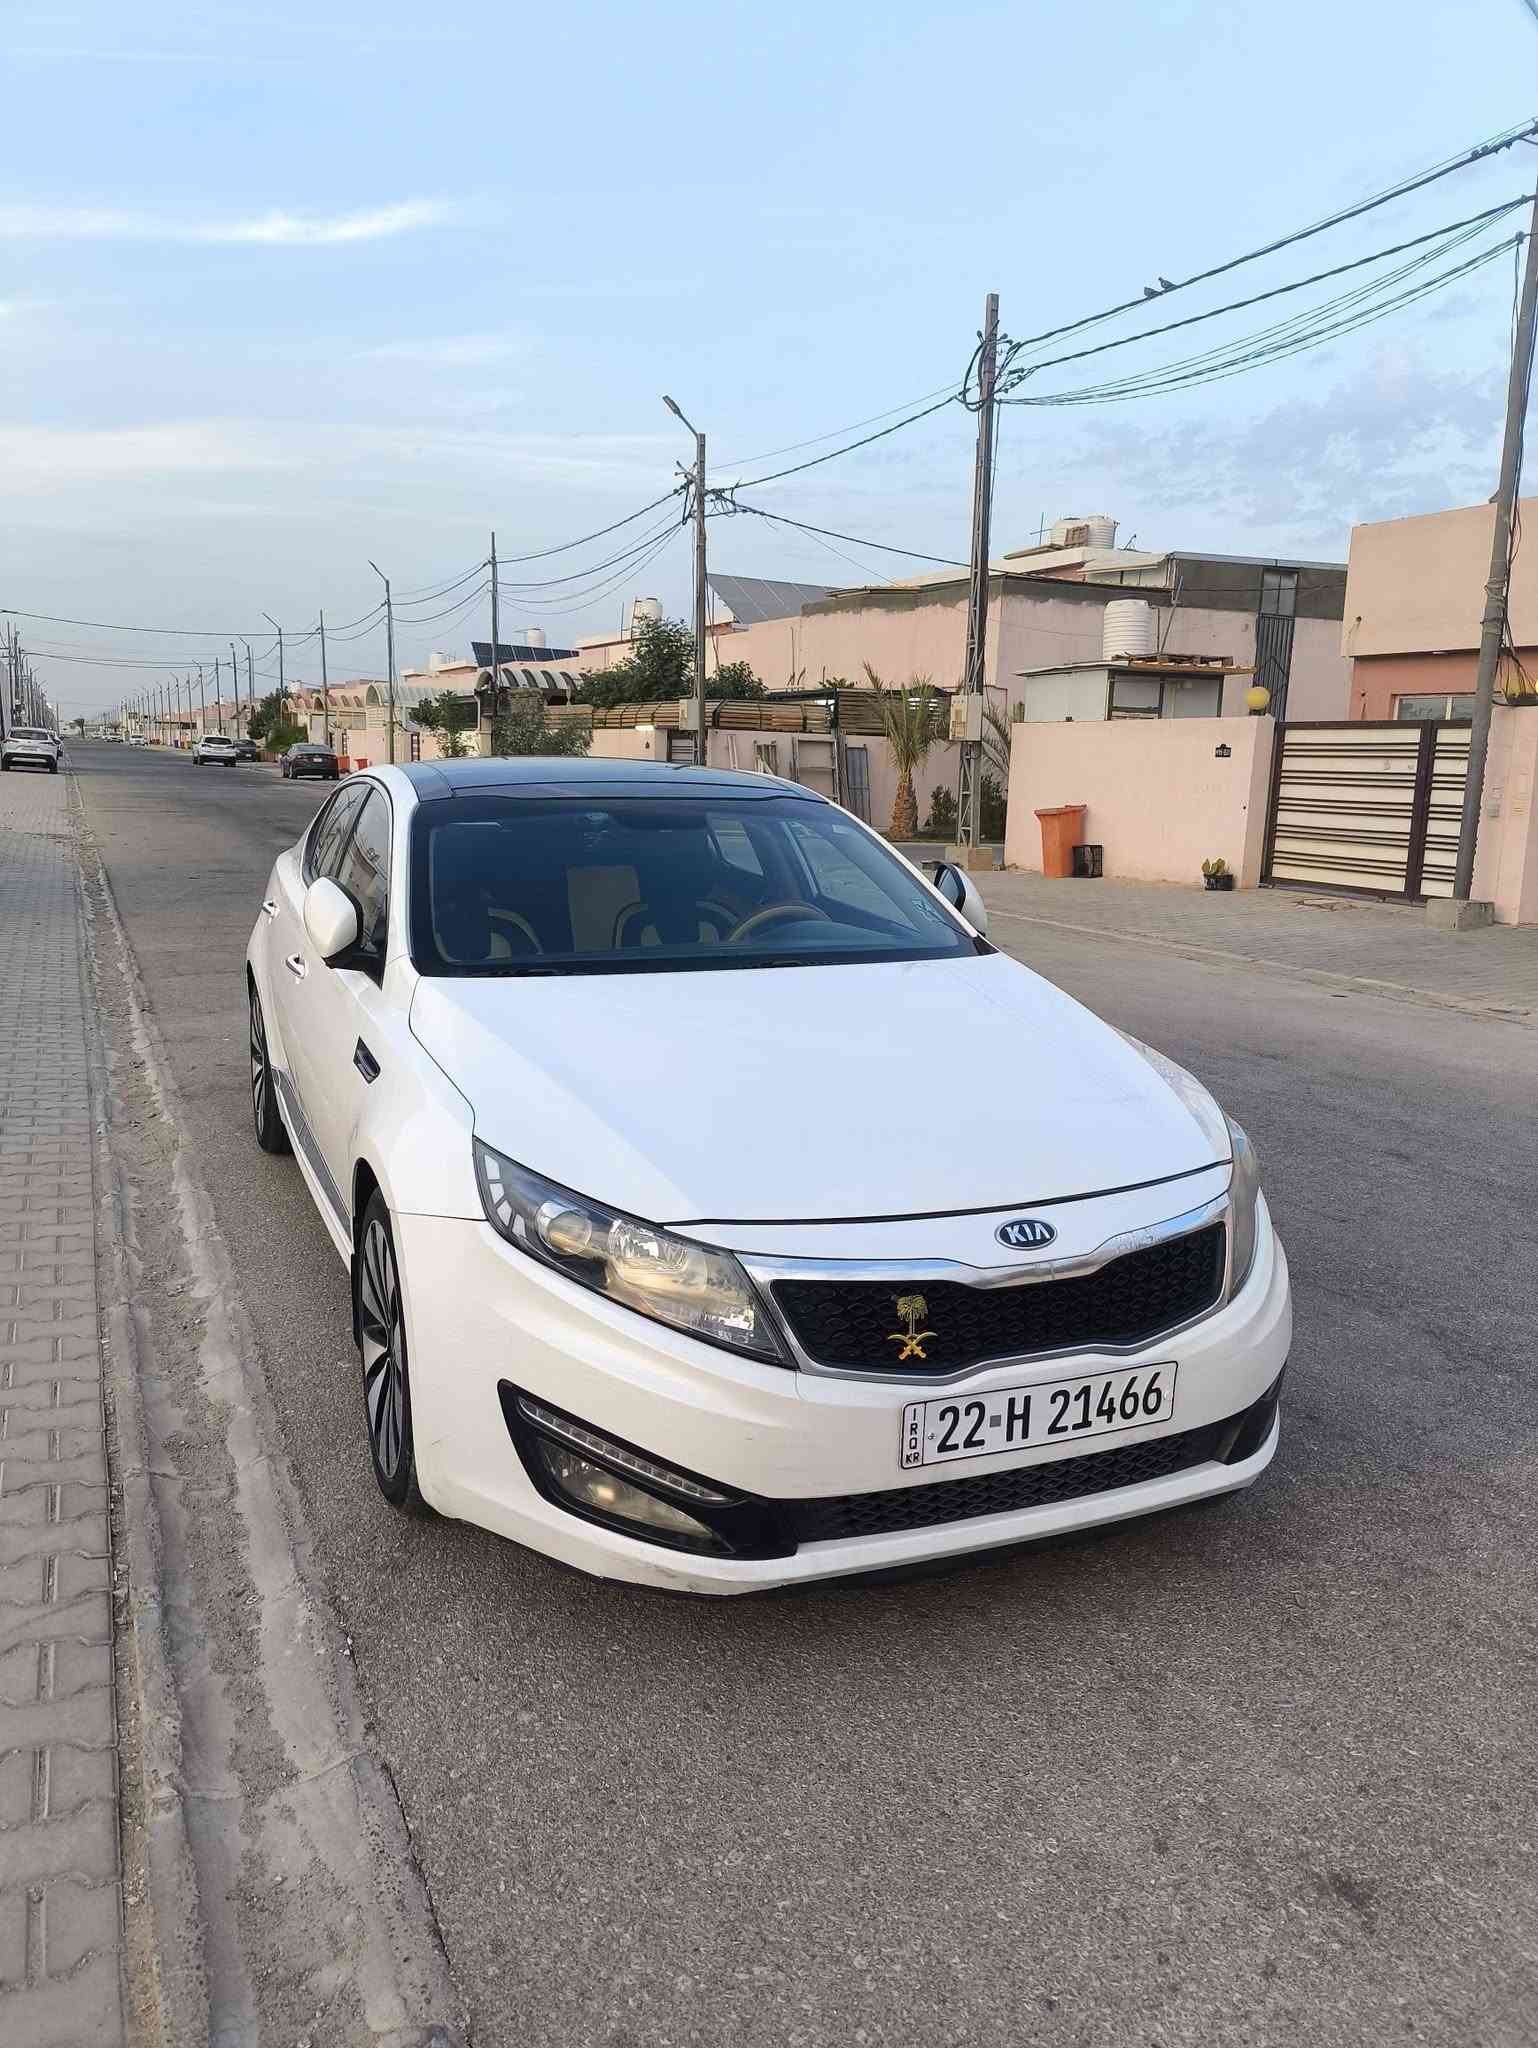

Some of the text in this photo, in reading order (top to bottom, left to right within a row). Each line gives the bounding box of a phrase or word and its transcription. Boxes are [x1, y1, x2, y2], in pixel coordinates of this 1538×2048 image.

[1005, 1223, 1050, 1243] KIA
[1047, 1372, 1162, 1435] 21466
[906, 1452, 919, 1464] KR
